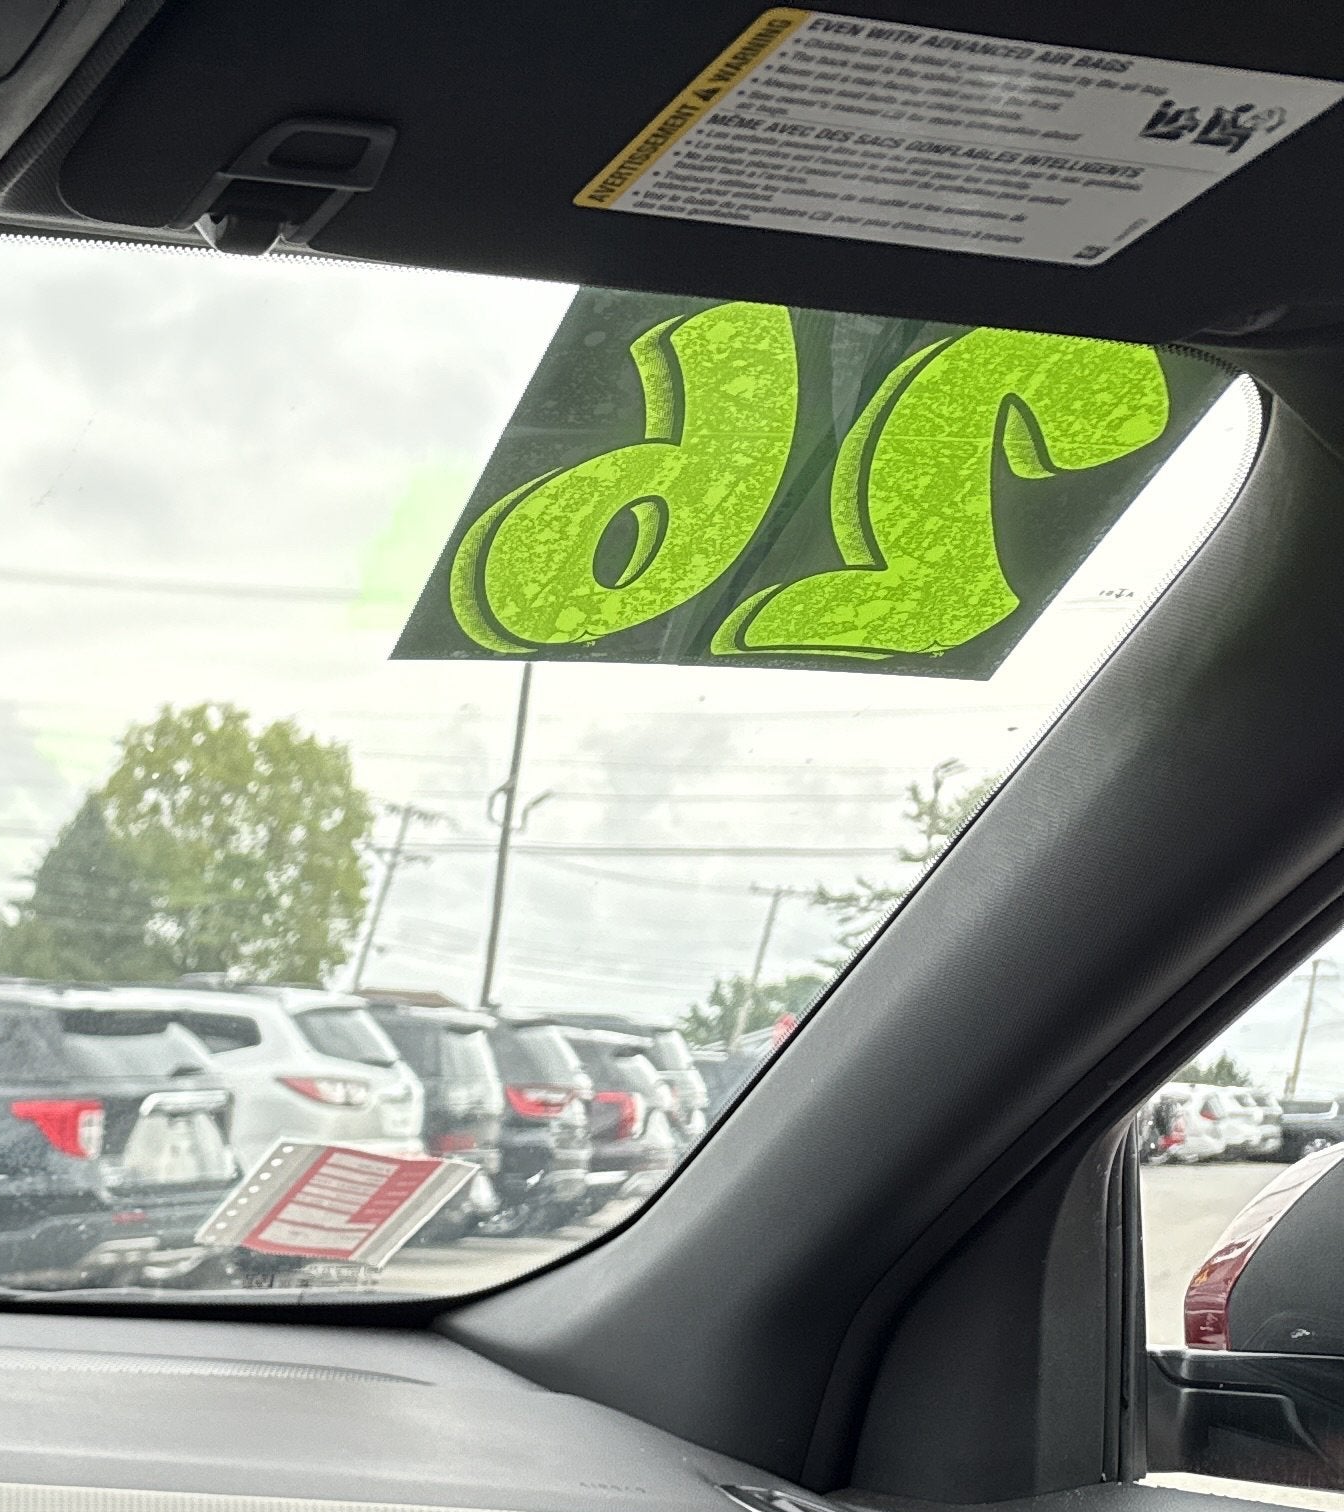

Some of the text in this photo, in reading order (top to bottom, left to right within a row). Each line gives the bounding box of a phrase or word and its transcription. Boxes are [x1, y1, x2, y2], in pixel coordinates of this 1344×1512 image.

[708, 18, 794, 91] WARNING
[804, 17, 1137, 74] EVEN WITH ADVANCED AIR BAGS
[703, 110, 770, 130] MÊME
[761, 120, 819, 137] AVEC
[812, 127, 858, 142] DES
[851, 132, 909, 149] SACS
[1017, 153, 1148, 180] INTELLIGENTS
